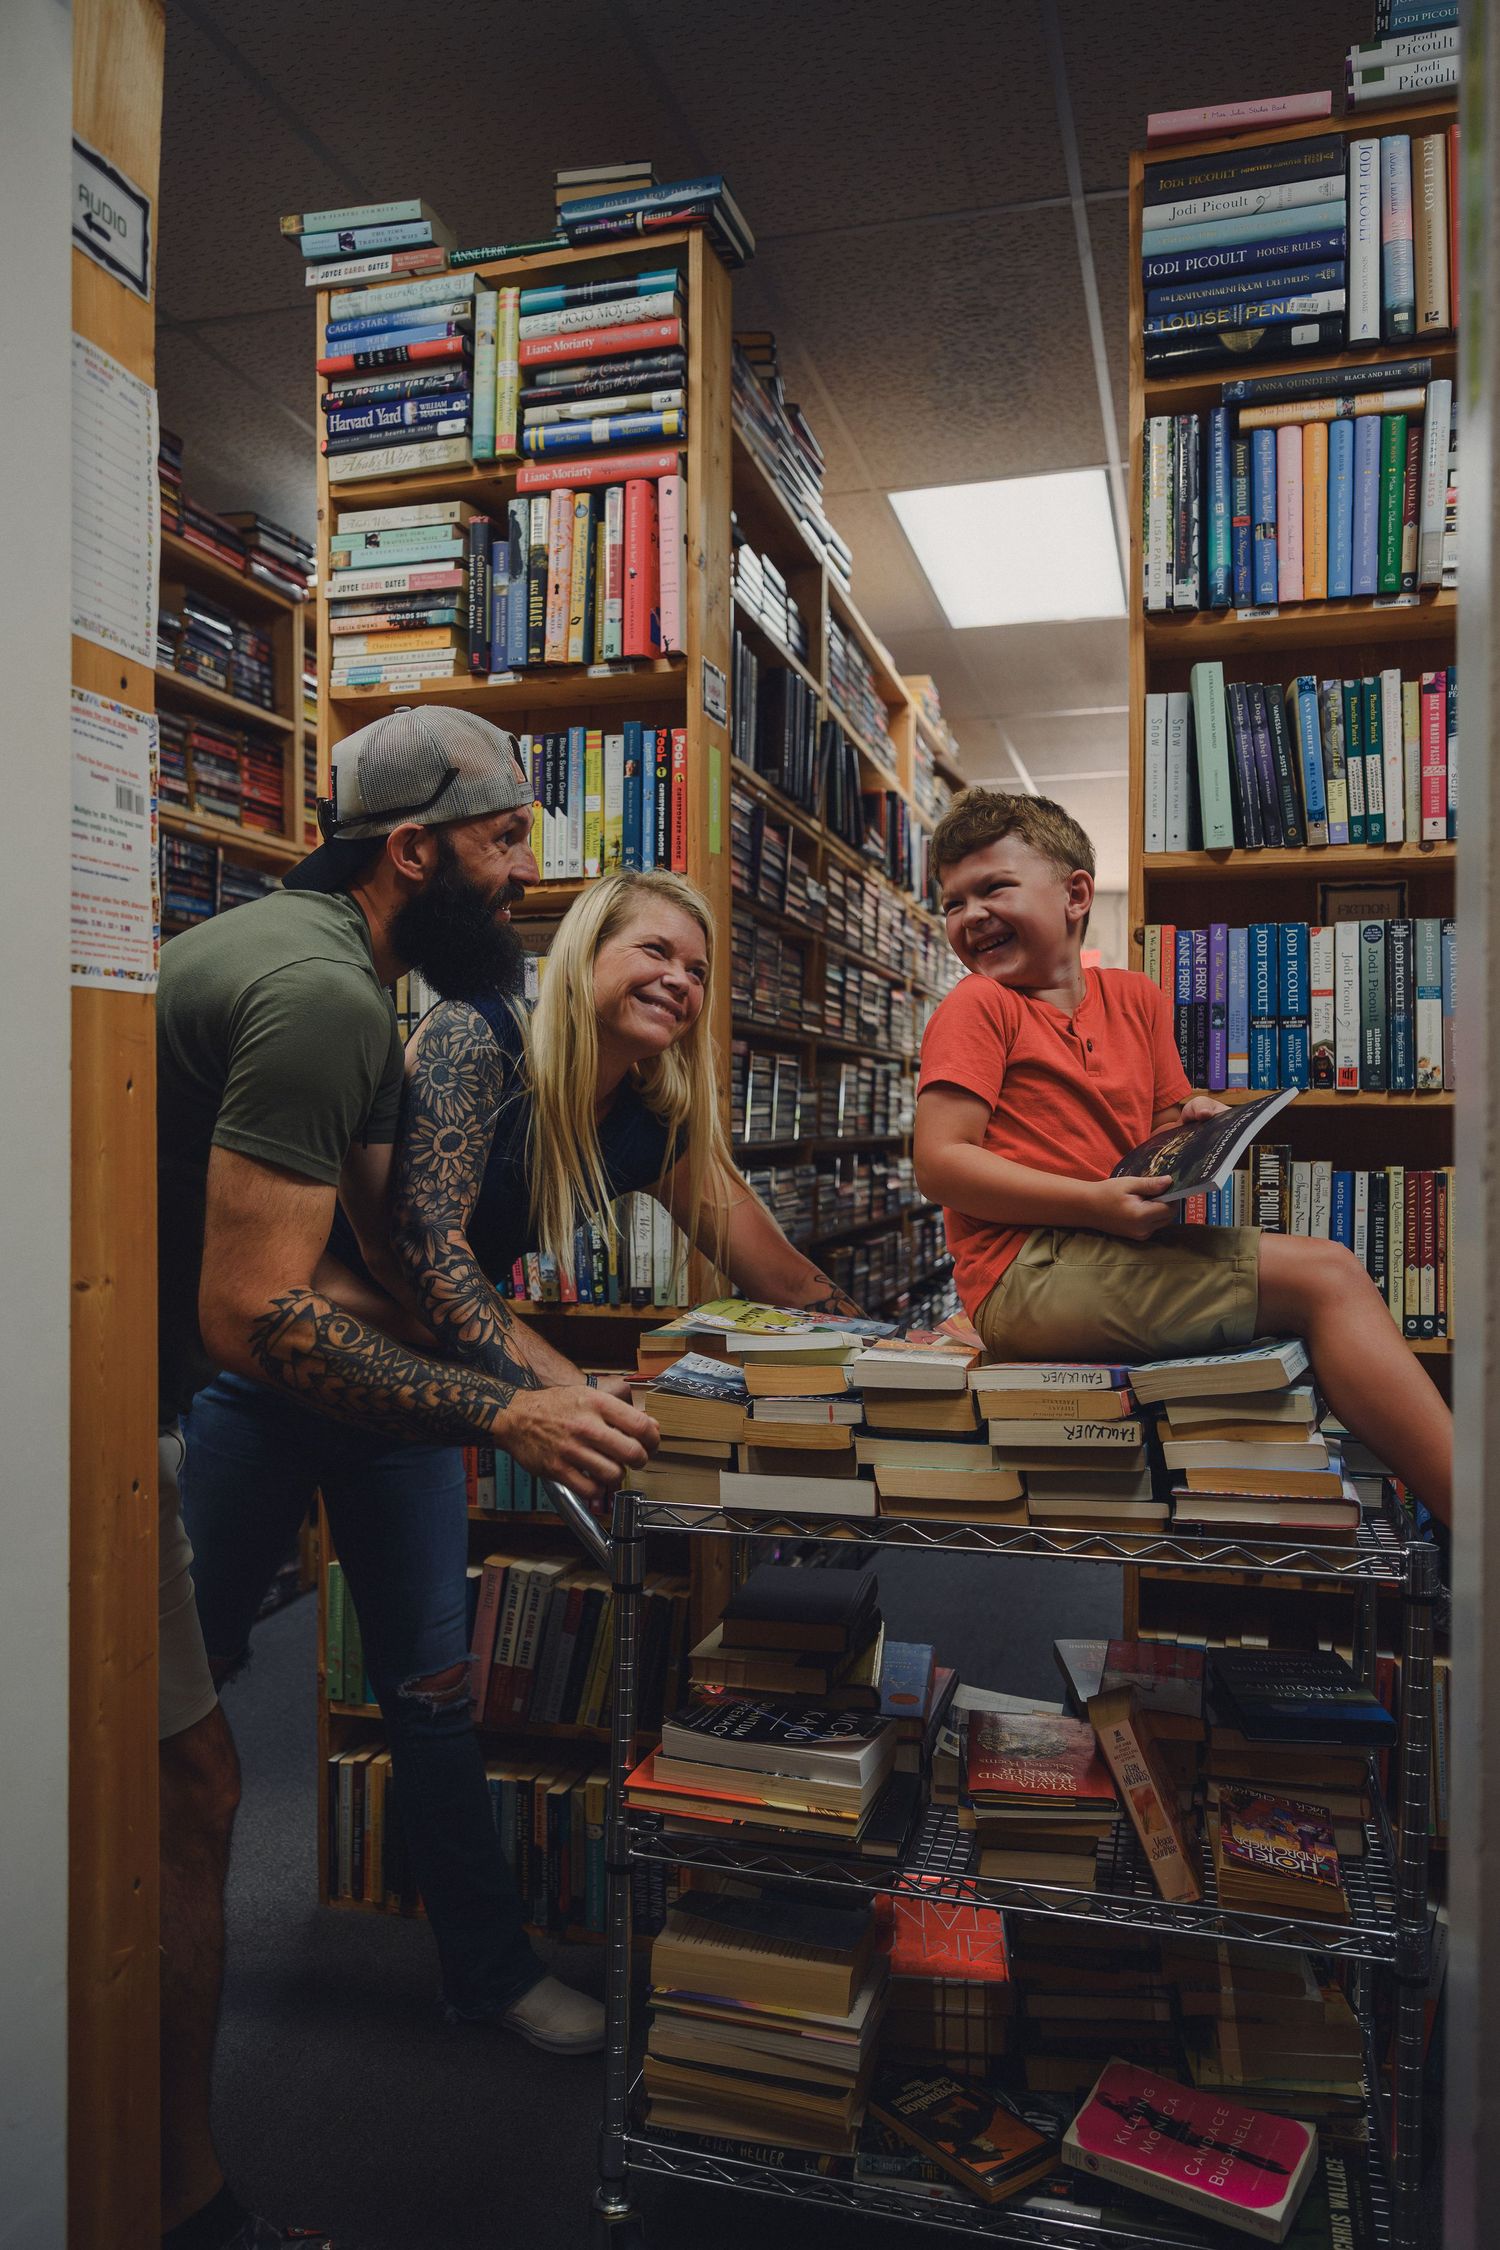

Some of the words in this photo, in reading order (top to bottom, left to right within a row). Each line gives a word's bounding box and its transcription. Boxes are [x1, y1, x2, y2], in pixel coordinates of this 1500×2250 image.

[1393, 15, 1418, 26] JODI
[1396, 36, 1455, 56] Picoult
[1411, 32, 1437, 42] Jodi
[1399, 68, 1456, 90] Picoult
[1414, 60, 1440, 74] Jodi
[1359, 146, 1373, 178] JODI
[79, 184, 127, 237] AUDIO
[1169, 205, 1197, 221] Jodi
[1203, 196, 1248, 213] Picoult
[1359, 184, 1371, 244] PICOULT
[321, 269, 342, 278] JOYCE
[344, 265, 365, 275] CAROL
[368, 262, 389, 271] OATES
[1148, 262, 1179, 278] JODI
[1186, 250, 1247, 269] PICOULT
[1257, 245, 1289, 257] HOUSE
[1292, 241, 1321, 252] RULES
[328, 325, 352, 334] CAGE
[361, 318, 388, 328] STARS
[562, 308, 593, 325] JOJO
[598, 302, 641, 320] MOYES
[1160, 310, 1229, 331] LOUISE
[526, 341, 551, 356] Liane
[554, 338, 595, 353] Moriarty
[1256, 382, 1284, 392] ANNA
[1286, 376, 1338, 388] QUINDLEN
[1344, 373, 1364, 381] BLACK
[1384, 370, 1401, 378] BLUE
[330, 410, 373, 432] Harvard
[375, 406, 401, 426] Yard
[1215, 415, 1222, 428] WE
[1215, 431, 1223, 449] ARE
[1409, 434, 1419, 461] ANNA
[524, 469, 549, 483] Liane
[551, 465, 593, 481] Moriarty
[1215, 470, 1224, 497] LIGHT
[1407, 464, 1418, 516] QUINDLEN
[338, 584, 358, 592] JOYCE
[362, 582, 383, 590] CAROL
[385, 579, 406, 588] OATES
[477, 555, 485, 596] Collector
[1216, 568, 1224, 595] QUICK
[476, 607, 484, 634] Hearts
[515, 590, 523, 648] SOURLAND
[1172, 719, 1184, 747] Snow
[1237, 704, 1245, 725] Dogs
[1241, 734, 1249, 757] Babel
[1273, 705, 1281, 734] VANESSA
[1279, 755, 1287, 776] SISTER
[1305, 716, 1314, 755] PATCHETT
[546, 739, 554, 758] Black
[559, 738, 567, 757] Black
[656, 728, 667, 762] FOOL
[674, 735, 685, 768] FOOL
[546, 761, 554, 780] Swan
[545, 783, 553, 805] Green
[558, 782, 566, 804] Green
[657, 783, 665, 829] CHRISTOPHER
[1328, 781, 1336, 814] Patchett
[1338, 904, 1391, 915] FICTION
[1256, 928, 1267, 956] JODI
[1285, 928, 1298, 956] JODI
[1424, 922, 1434, 942] jodi
[1179, 936, 1190, 966] ANNE
[1324, 951, 1332, 974] JODI
[1342, 953, 1353, 975] Jodi
[1368, 948, 1378, 974] Jodi
[1424, 946, 1435, 981] picoult
[1179, 969, 1190, 1000] PERRY
[1258, 961, 1268, 1012] PICOULT
[1288, 961, 1298, 1012] PICOULT
[1343, 980, 1353, 1015] Picoult
[1181, 1006, 1186, 1018] NO
[1368, 979, 1378, 1022] Picoult
[1181, 1045, 1187, 1054] AS
[1259, 1154, 1279, 1185] ANNIE
[1424, 1178, 1432, 1204] ANNA
[1259, 1190, 1279, 1230] PROULX
[1392, 1202, 1401, 1234] Quindlen
[1407, 1208, 1416, 1258] QUINDLEN
[1424, 1208, 1432, 1258] QUINDLEN
[1393, 1249, 1401, 1273] Object
[1394, 1276, 1402, 1303] Lessons
[1041, 1372, 1102, 1384] FAULKNER
[1064, 1424, 1135, 1442] FAULKNER
[483, 1573, 497, 1610] BLONDE
[508, 1584, 519, 1610] JOYCE
[528, 1587, 540, 1612] JOYCE
[504, 1612, 515, 1635] CAROL
[525, 1615, 536, 1638] CAROL
[499, 1638, 511, 1662] OATES
[519, 1641, 531, 1665] OATES
[784, 1710, 828, 1740] KAKU
[978, 1772, 1071, 1784] TOWNSEND
[1001, 1768, 1074, 1778] WARNER
[1023, 1761, 1074, 1770] Selected
[1020, 1782, 1077, 1791] SYLVIA
[1152, 1835, 1174, 1848] Vegas
[1152, 1845, 1178, 1861] Sunrise
[1231, 1832, 1325, 1863] ANDROMEDA
[1242, 1845, 1318, 1875] HOTEL
[898, 2081, 962, 2115] Pygmalion
[1113, 2088, 1156, 2145] KILLING
[1138, 2097, 1181, 2155] MONICA
[1183, 2108, 1229, 2177] CANDACE
[1209, 2115, 1255, 2187] BUSHNELL
[1328, 2156, 1345, 2209] WALLACE
[1331, 2213, 1351, 2250] CHRIS
